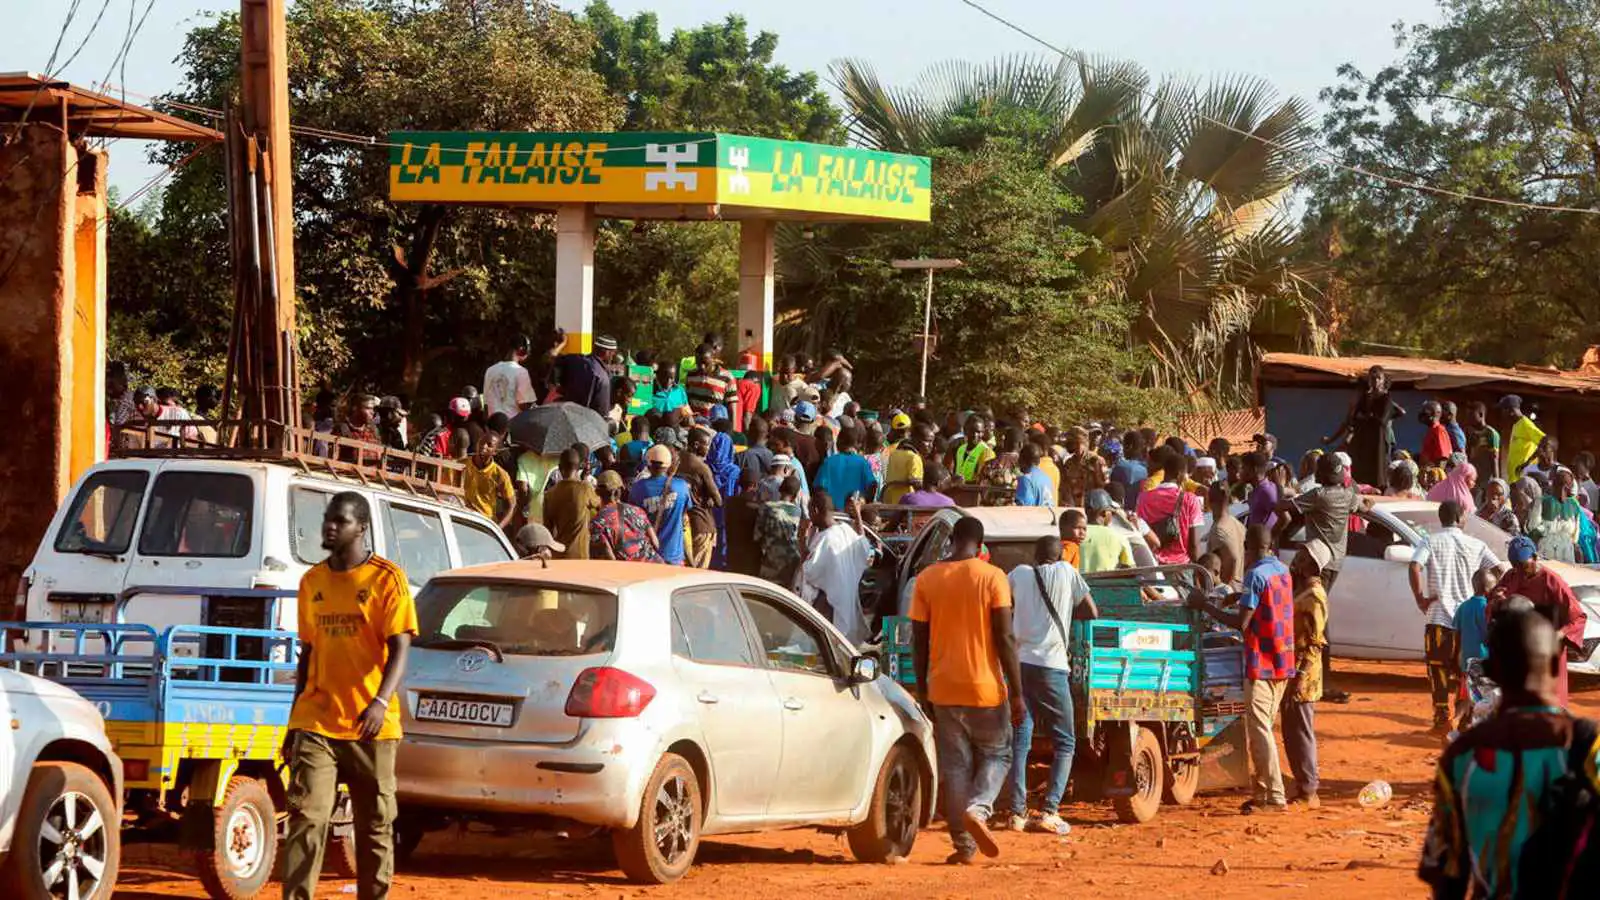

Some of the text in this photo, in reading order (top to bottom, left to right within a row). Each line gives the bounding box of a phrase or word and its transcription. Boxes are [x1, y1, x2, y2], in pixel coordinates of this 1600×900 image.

[397, 142, 608, 184] LA FALAISE
[771, 149, 919, 203] LA FALAISE
[428, 700, 500, 722] AA010CV
